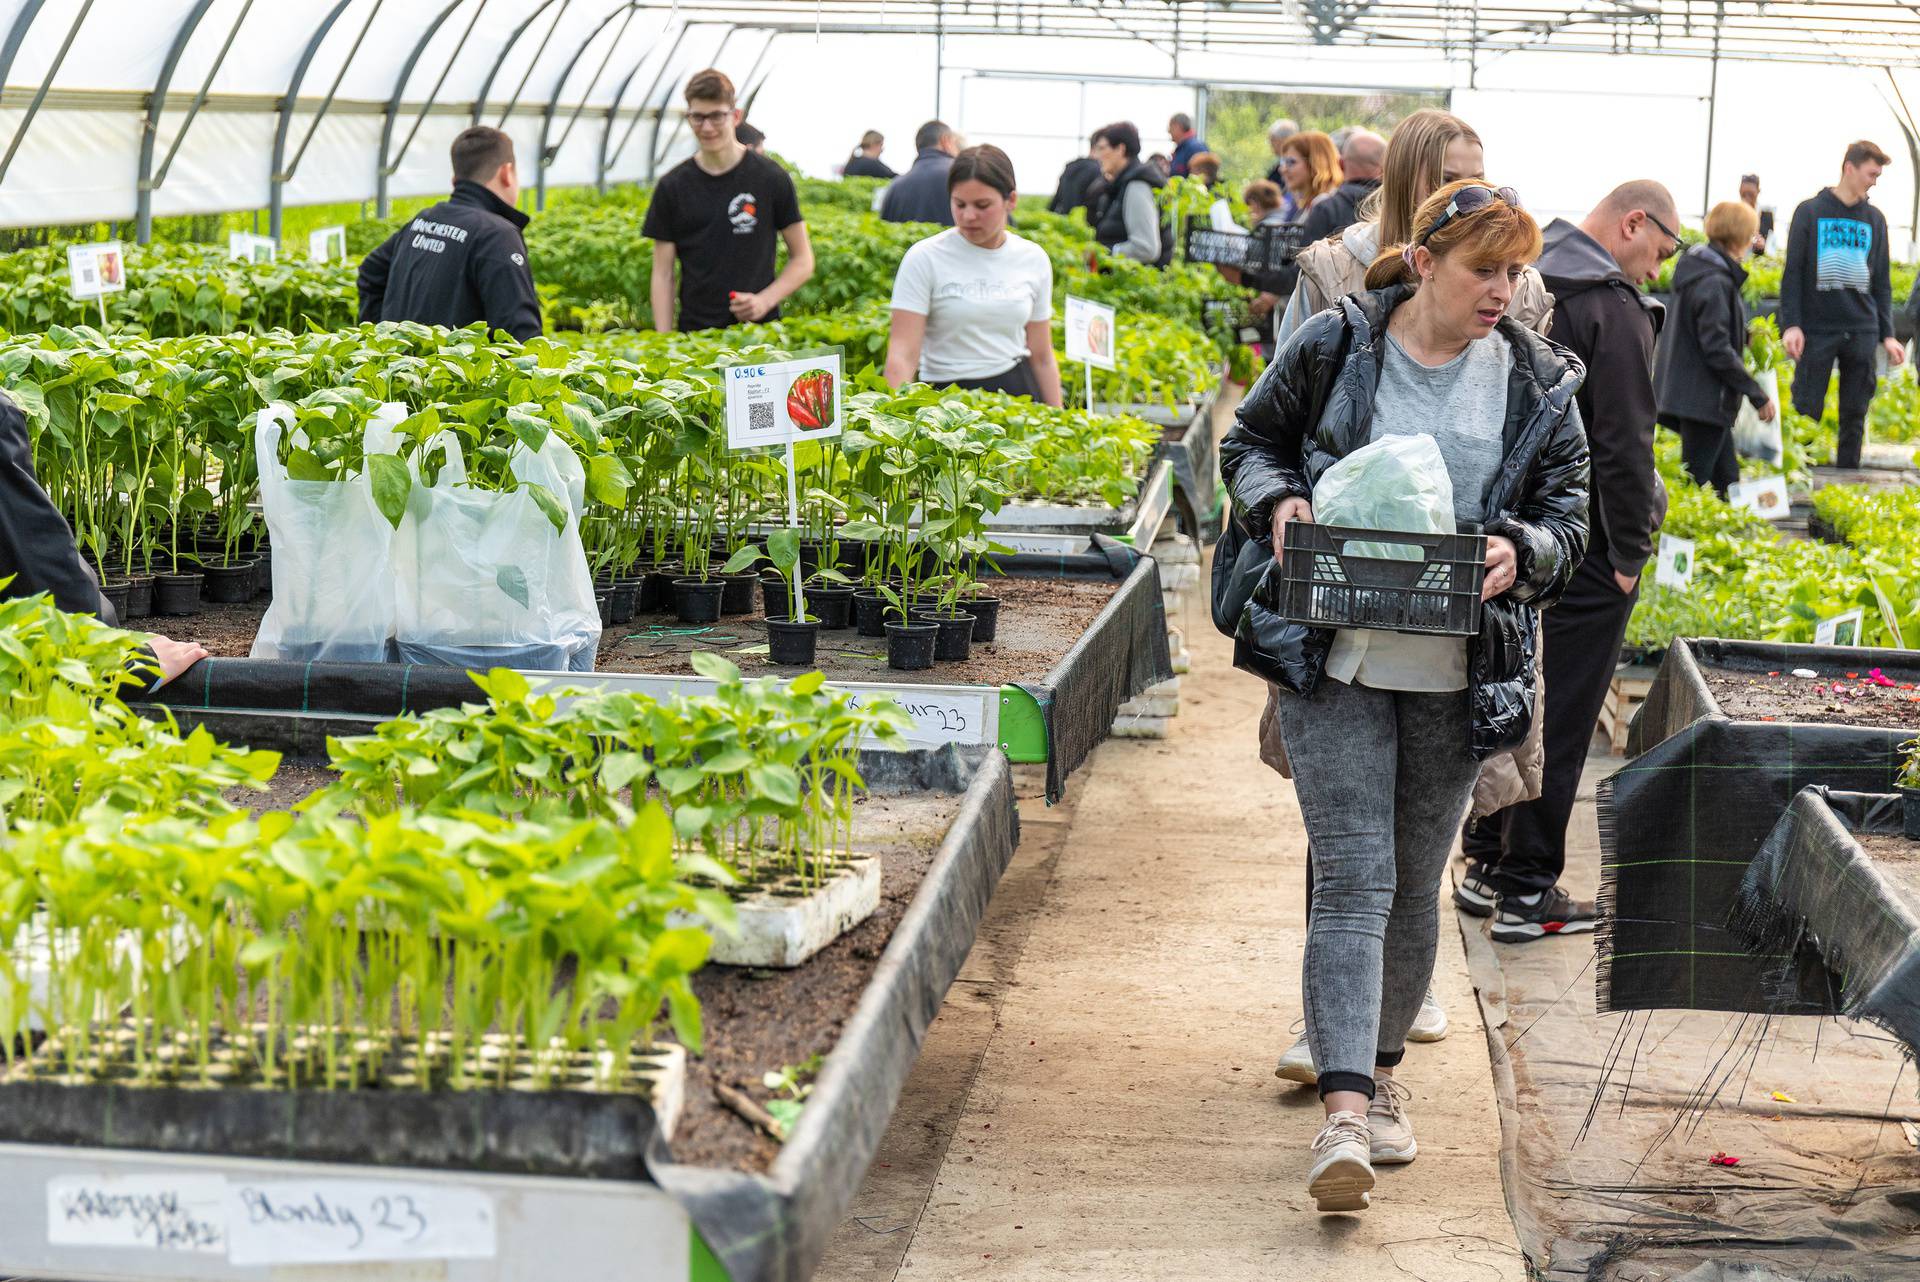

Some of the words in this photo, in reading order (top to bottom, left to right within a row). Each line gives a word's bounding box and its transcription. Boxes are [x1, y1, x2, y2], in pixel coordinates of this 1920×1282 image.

[410, 218, 468, 244] MANCHESTER
[411, 233, 446, 254] UNITED
[734, 367, 756, 379] 0.90
[757, 366, 766, 376] €
[936, 708, 966, 732] 23
[370, 1194, 427, 1243] 23
